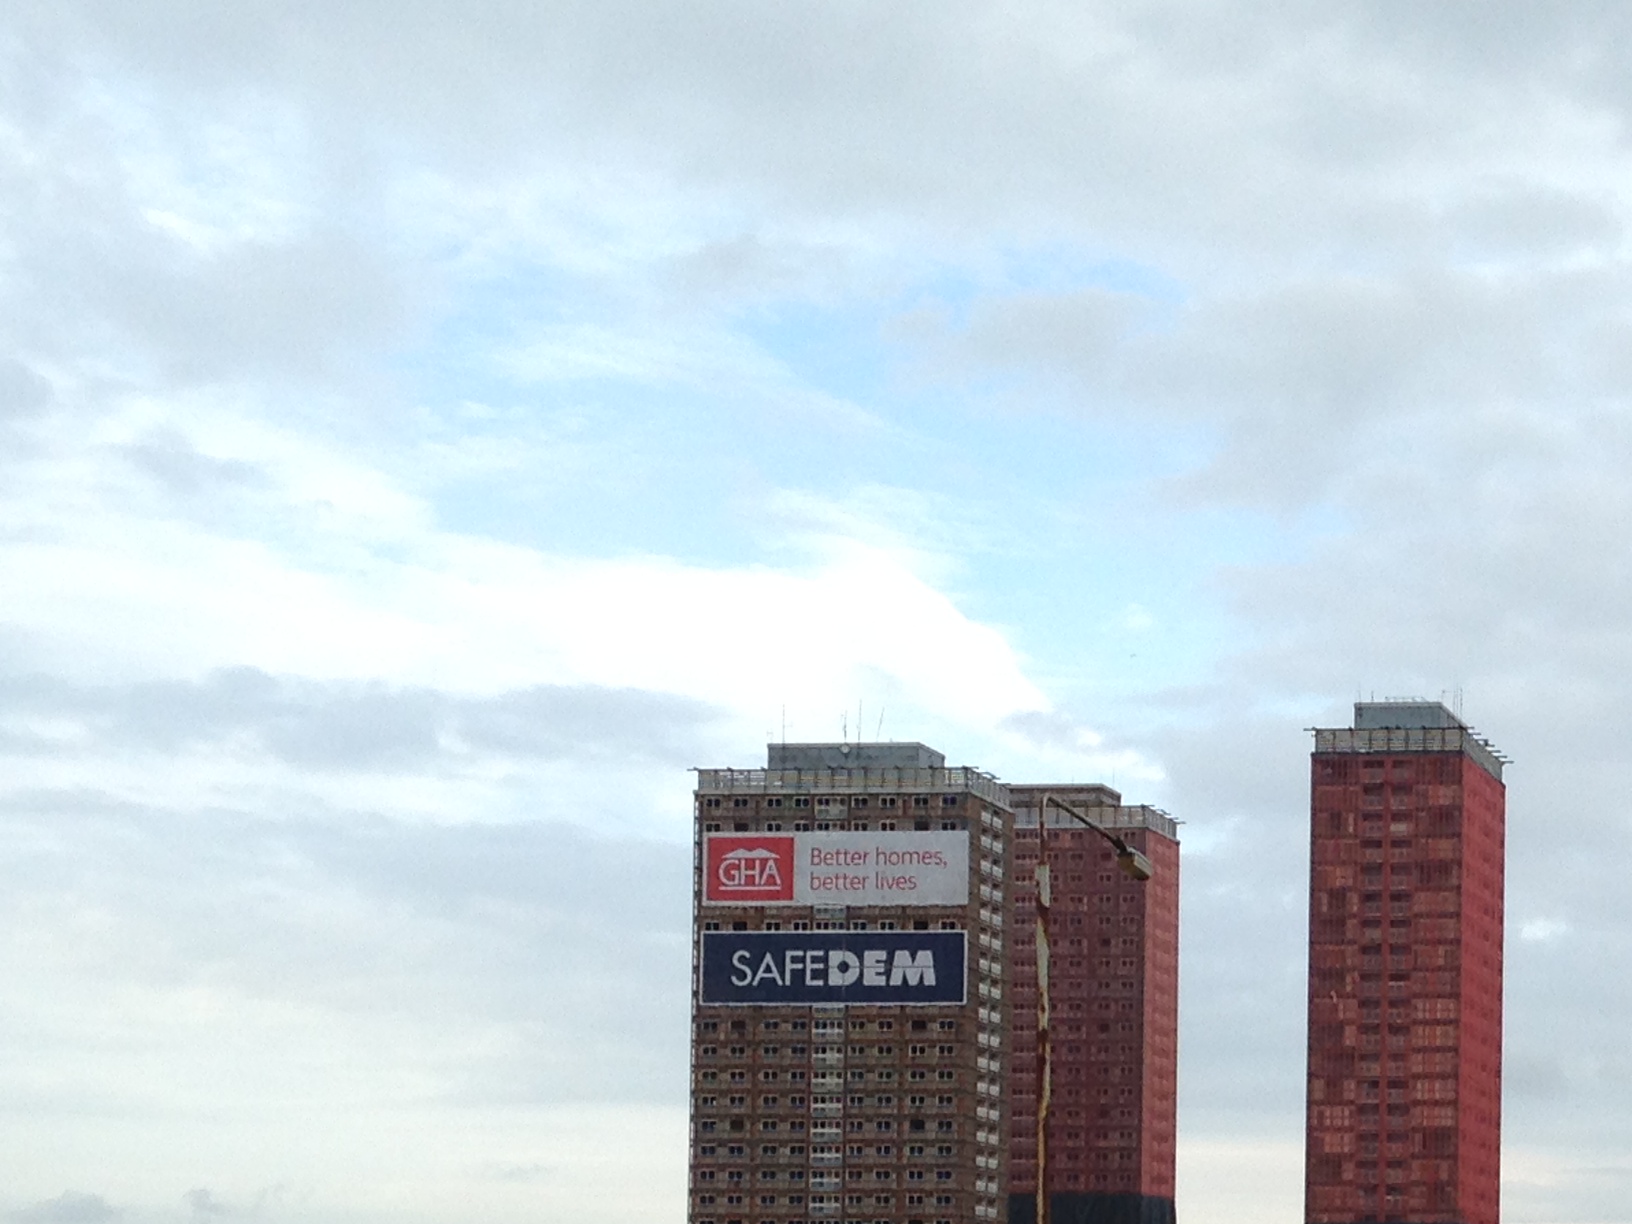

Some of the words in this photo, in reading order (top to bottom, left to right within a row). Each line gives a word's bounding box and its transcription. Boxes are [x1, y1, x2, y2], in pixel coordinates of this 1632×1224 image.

[810, 847, 869, 866] Better
[875, 846, 948, 869] homes,
[718, 858, 782, 887] GHA
[810, 871, 869, 891] better
[875, 871, 917, 890] lives
[730, 949, 937, 987] SAFEDEM
